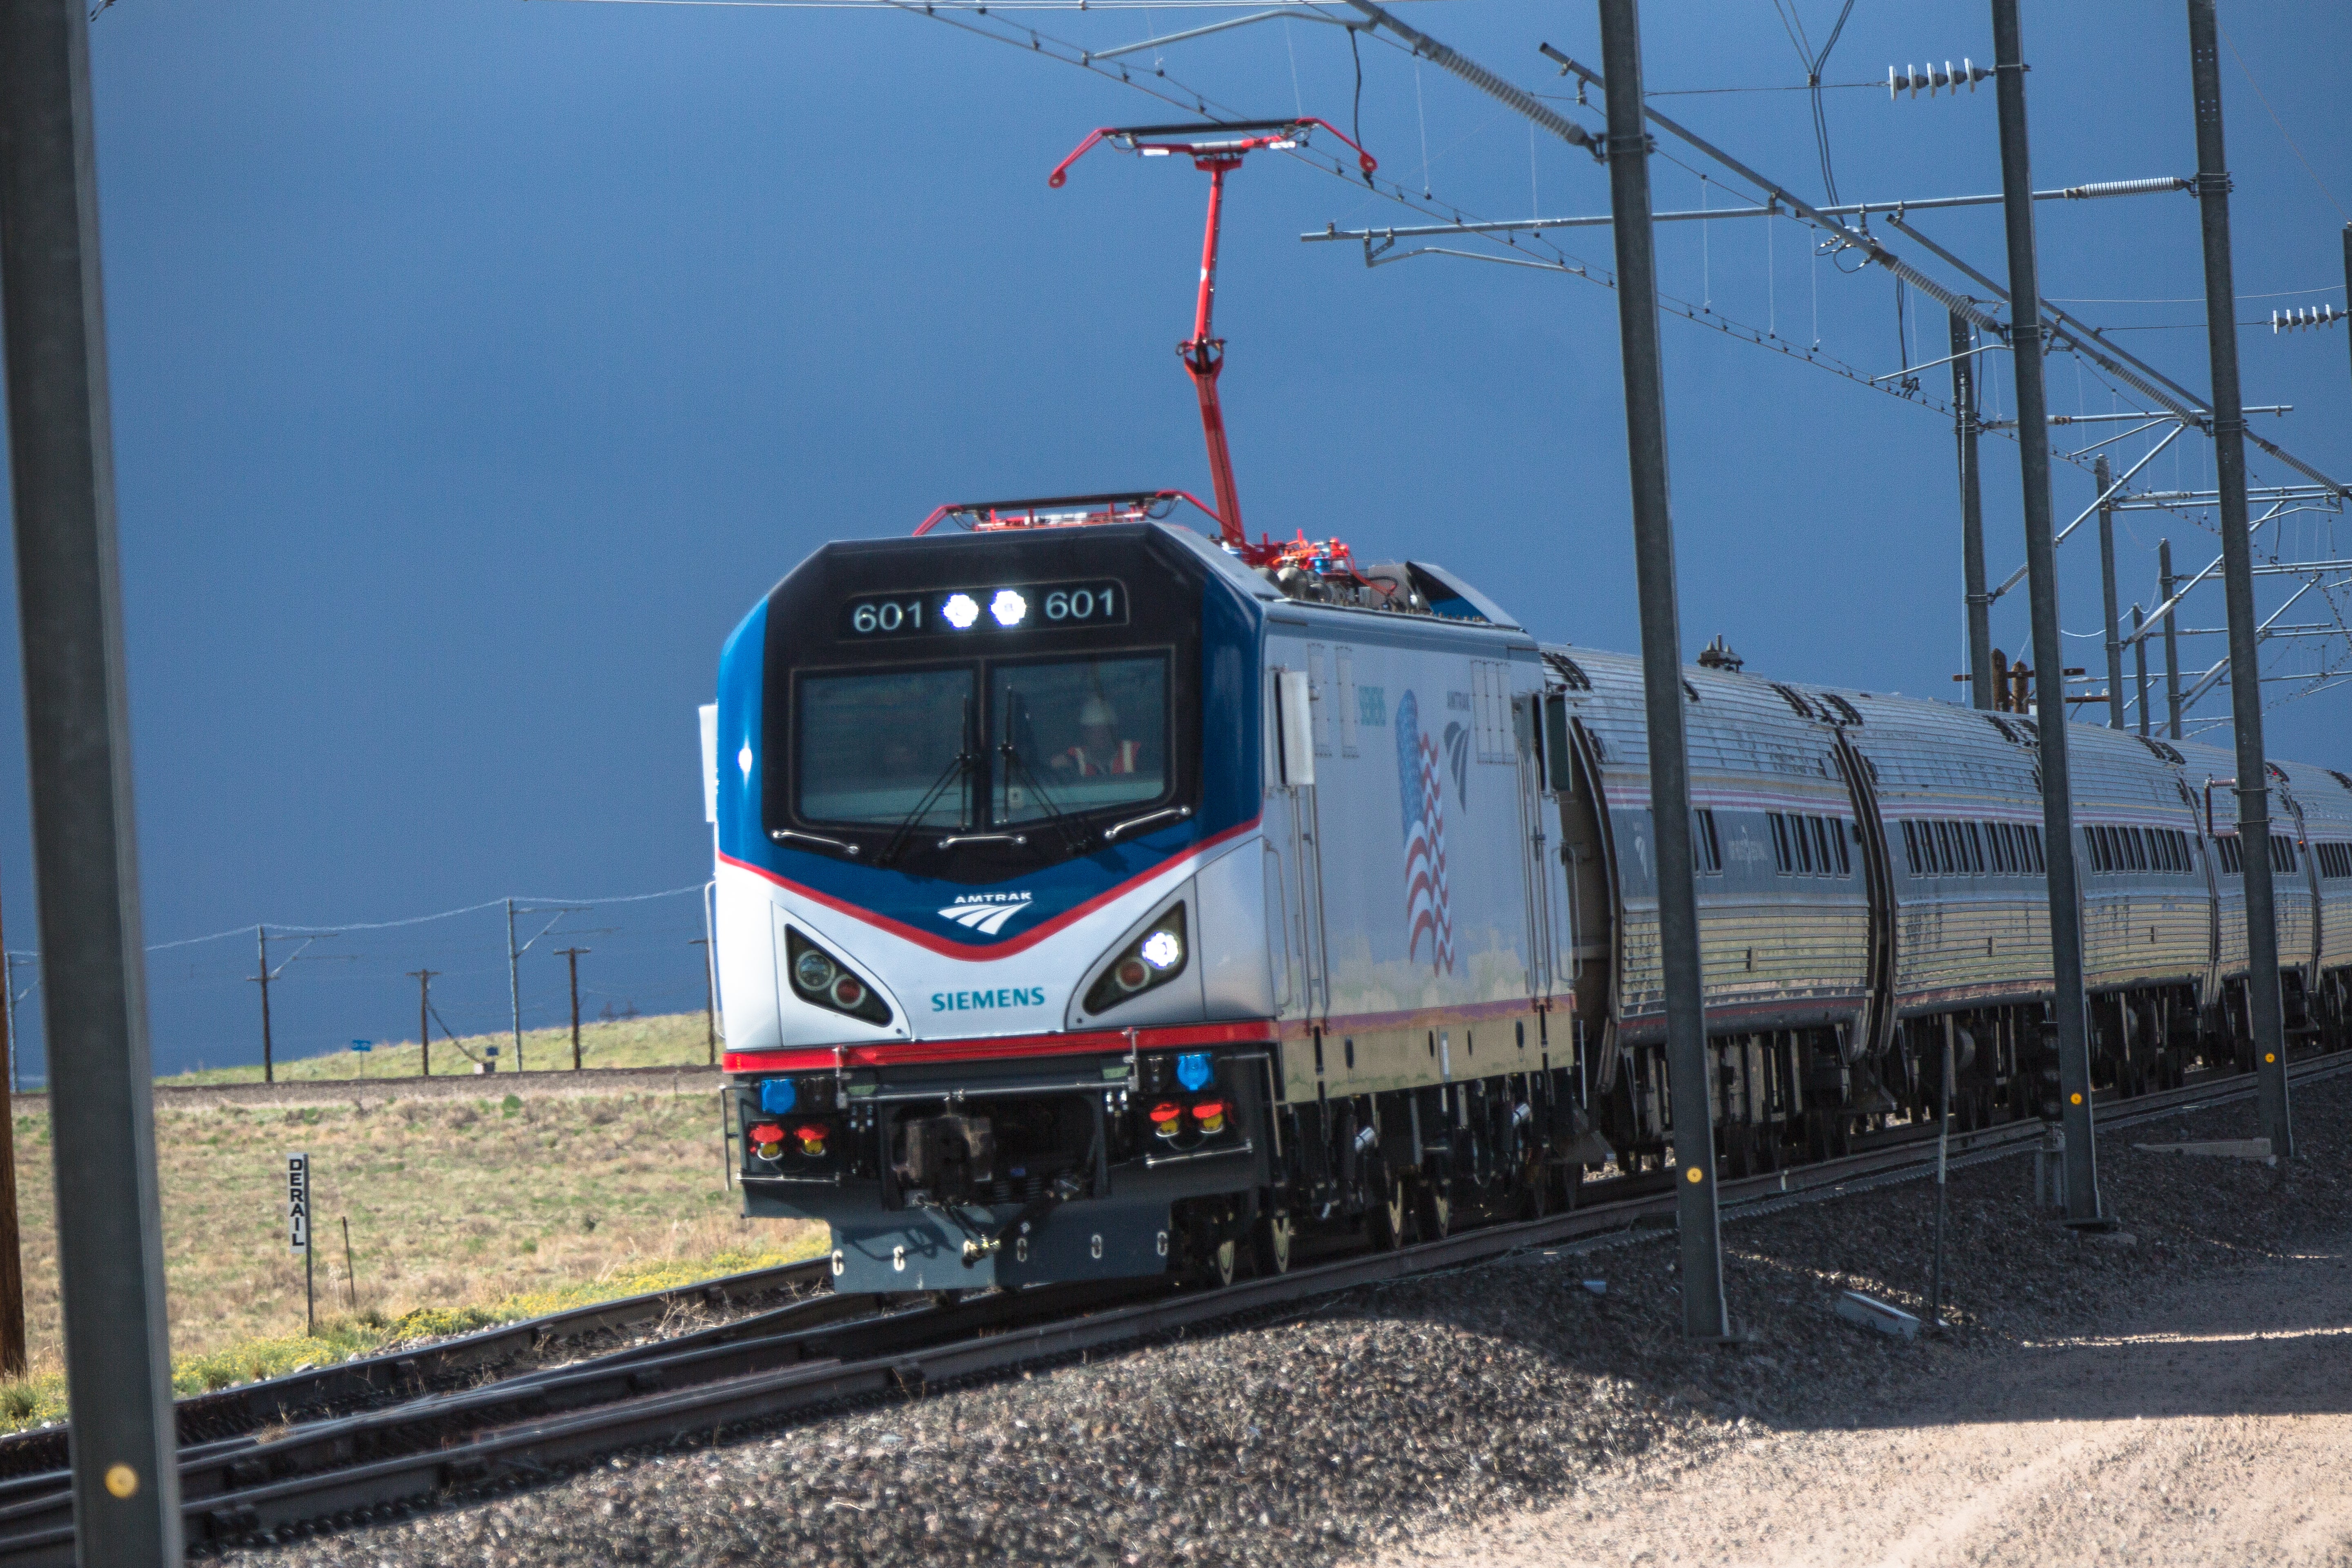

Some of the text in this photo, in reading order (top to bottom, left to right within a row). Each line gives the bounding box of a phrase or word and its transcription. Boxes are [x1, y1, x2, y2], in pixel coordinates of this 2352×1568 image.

[853, 602, 921, 632] 601
[1046, 589, 1114, 619] 601
[954, 891, 1032, 904] AMTRAK
[931, 987, 1045, 1012] SIEMENS
[290, 1159, 305, 1246] DERAIL
